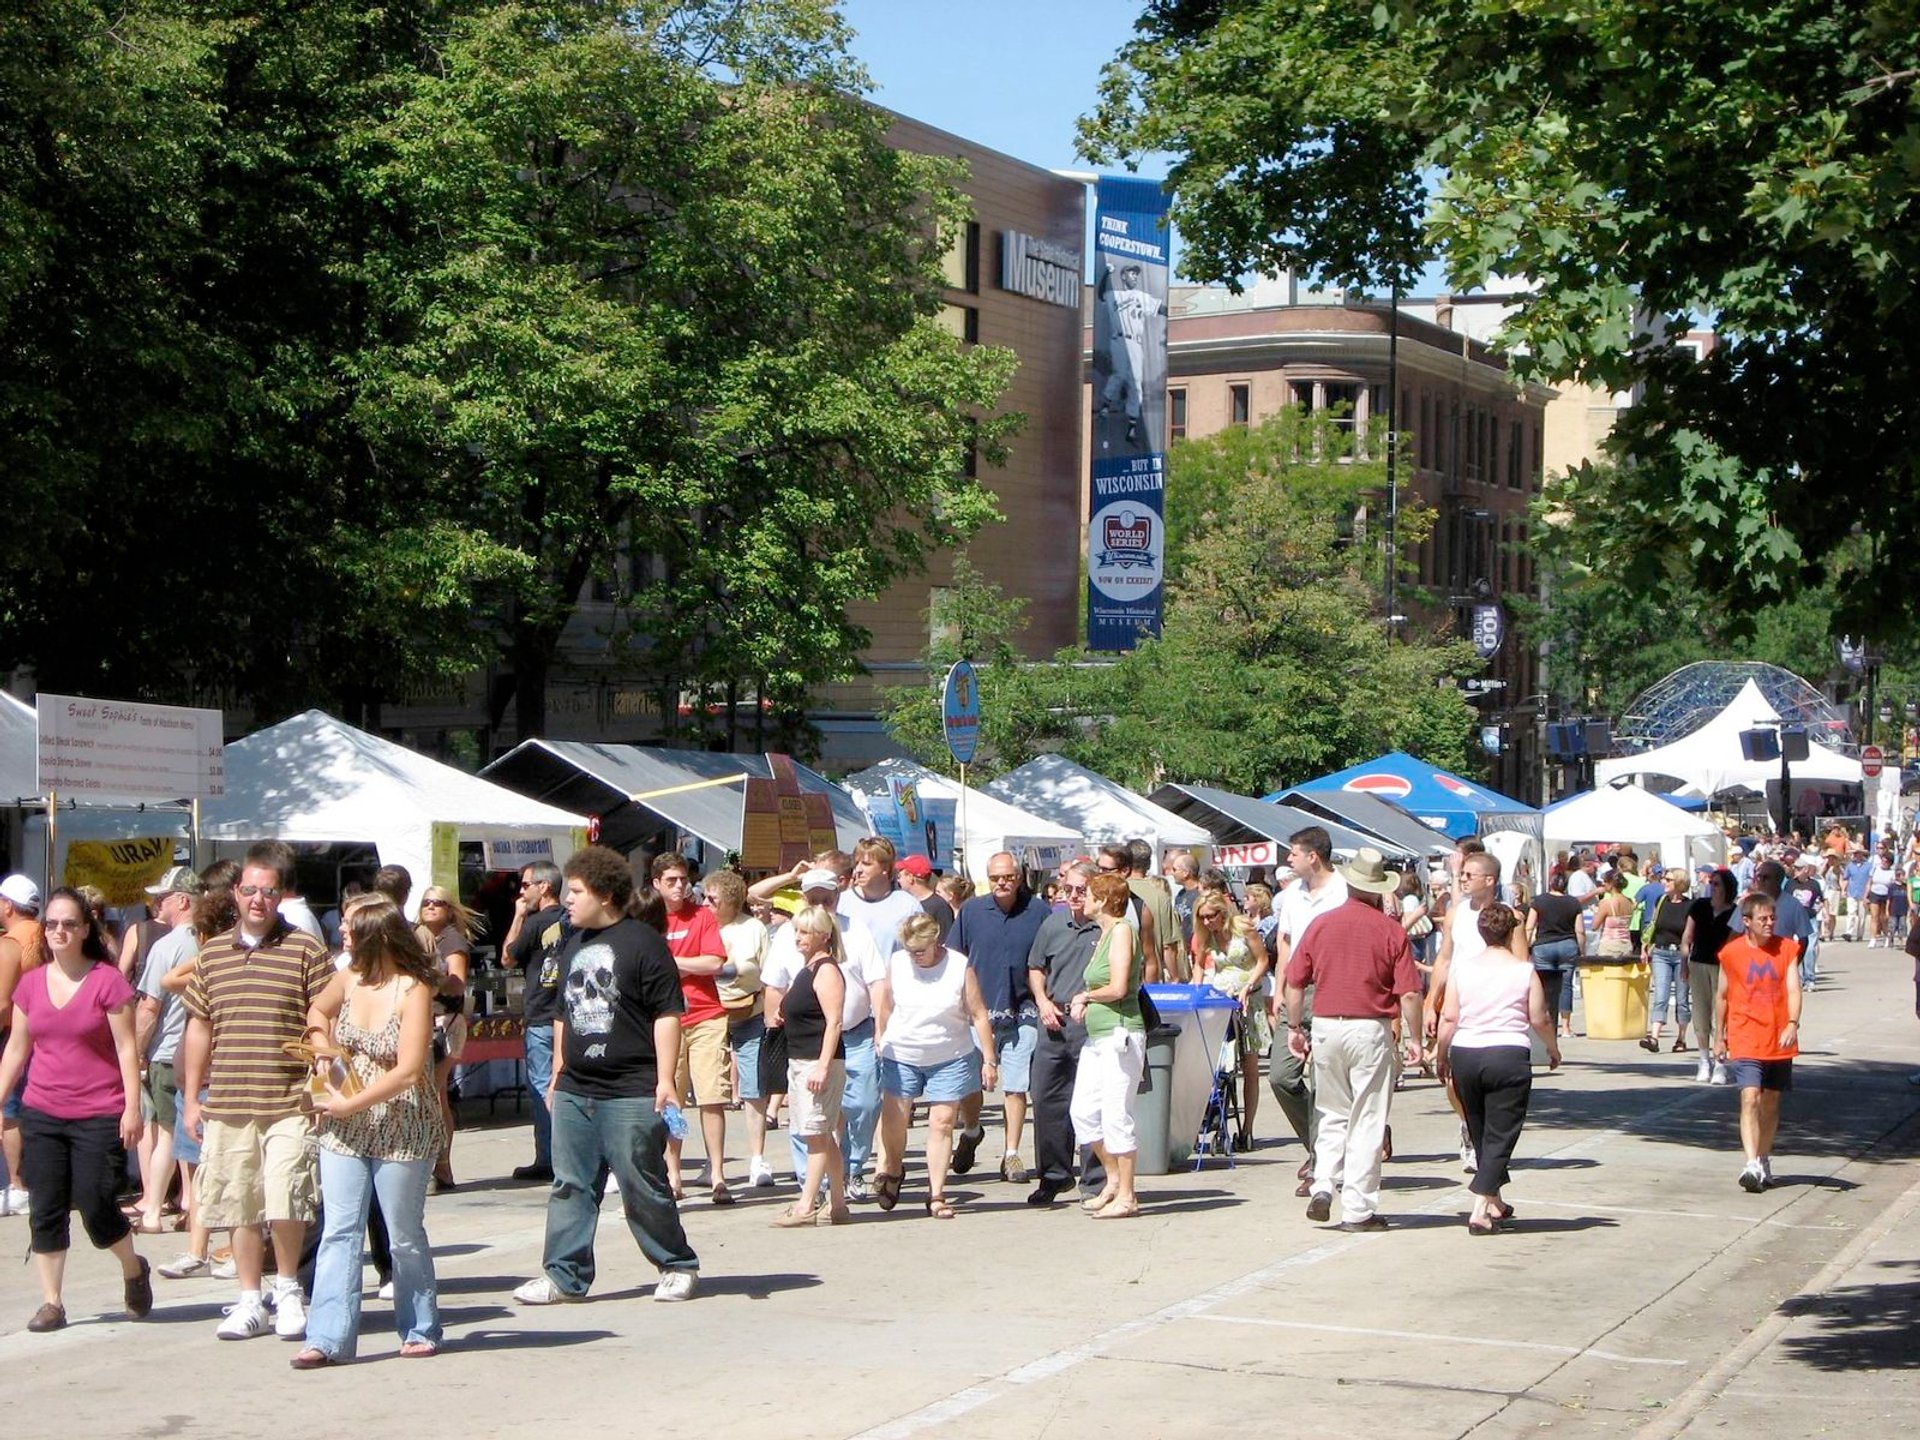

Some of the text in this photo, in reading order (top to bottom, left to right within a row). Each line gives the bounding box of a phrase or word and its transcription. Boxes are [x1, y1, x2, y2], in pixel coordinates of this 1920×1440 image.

[1101, 215, 1128, 234] THINK
[1008, 229, 1079, 308] Museum
[1095, 472, 1163, 495] WISCONSIN
[1108, 529, 1145, 539] WORLD
[1110, 538, 1143, 547] SERIES
[1098, 576, 1153, 585] NOW ON EXHIBIT
[1093, 606, 1157, 615] Wisconsin Historical
[1099, 618, 1151, 626] MUSEUM
[1473, 613, 1483, 646] BLOC
[1482, 606, 1498, 649] 100
[1747, 959, 1779, 985] M
